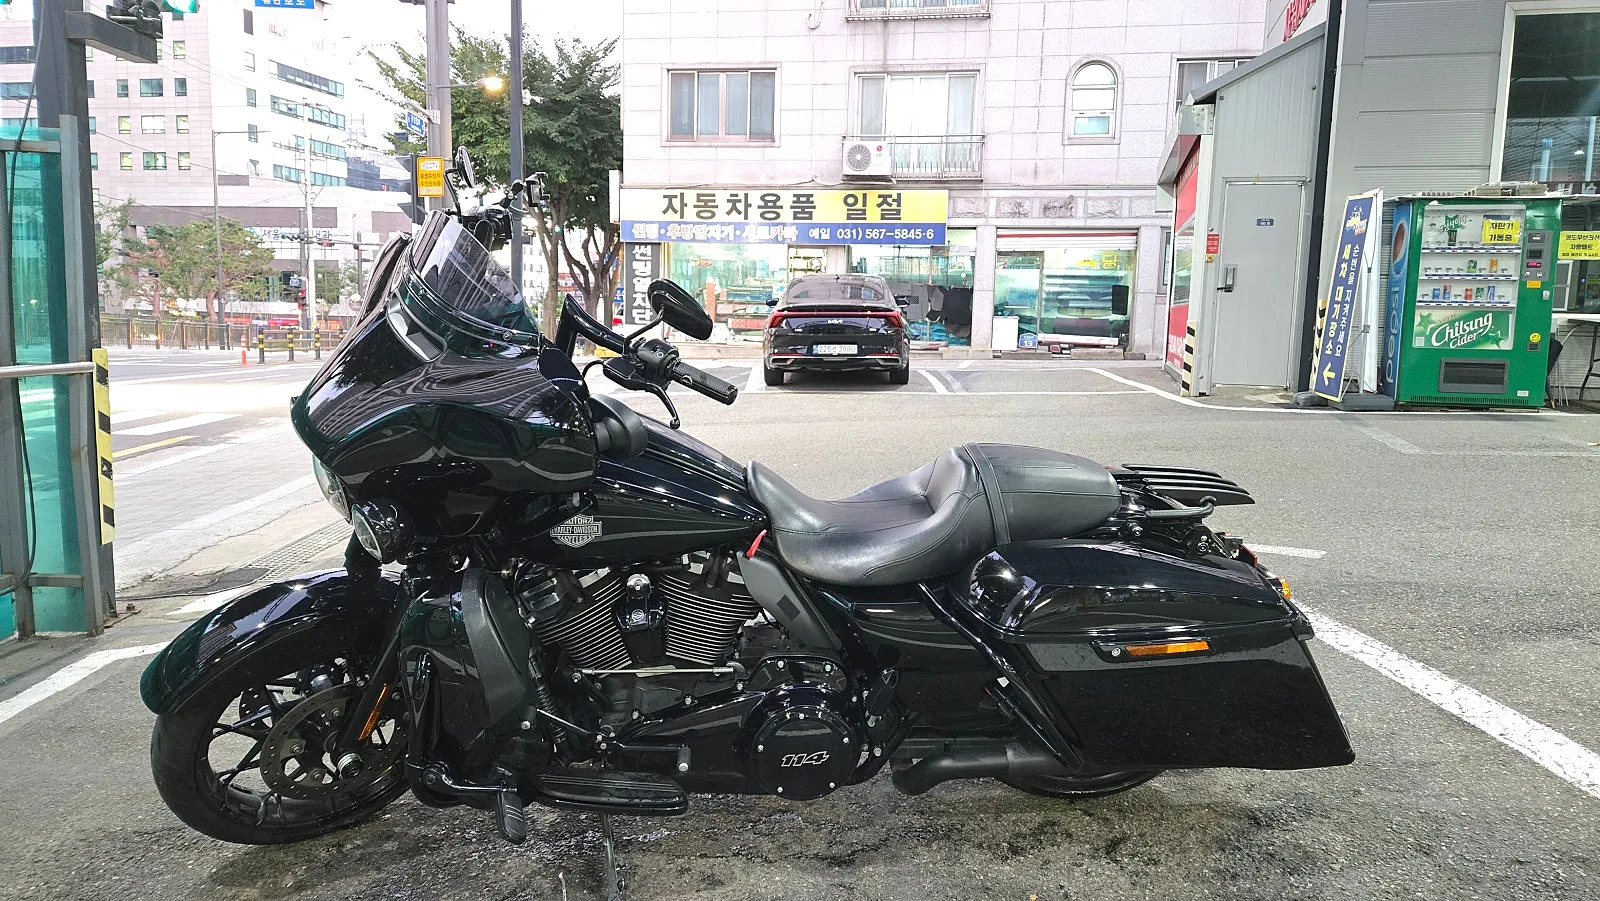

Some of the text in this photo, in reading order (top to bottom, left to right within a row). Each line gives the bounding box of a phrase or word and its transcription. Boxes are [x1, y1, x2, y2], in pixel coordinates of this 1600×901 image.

[661, 192, 902, 221] 자동차용품 일절
[1489, 222, 1514, 230] 자판기
[1489, 234, 1513, 242] 가동중
[1347, 243, 1360, 285] 순번을
[1325, 243, 1352, 355] 세차 대기장소
[1335, 289, 1353, 357] 지켜주세요
[1386, 286, 1400, 383] pepsi
[1431, 312, 1493, 347] Chilsung
[1449, 329, 1483, 349] Cider
[781, 750, 830, 767] 114
